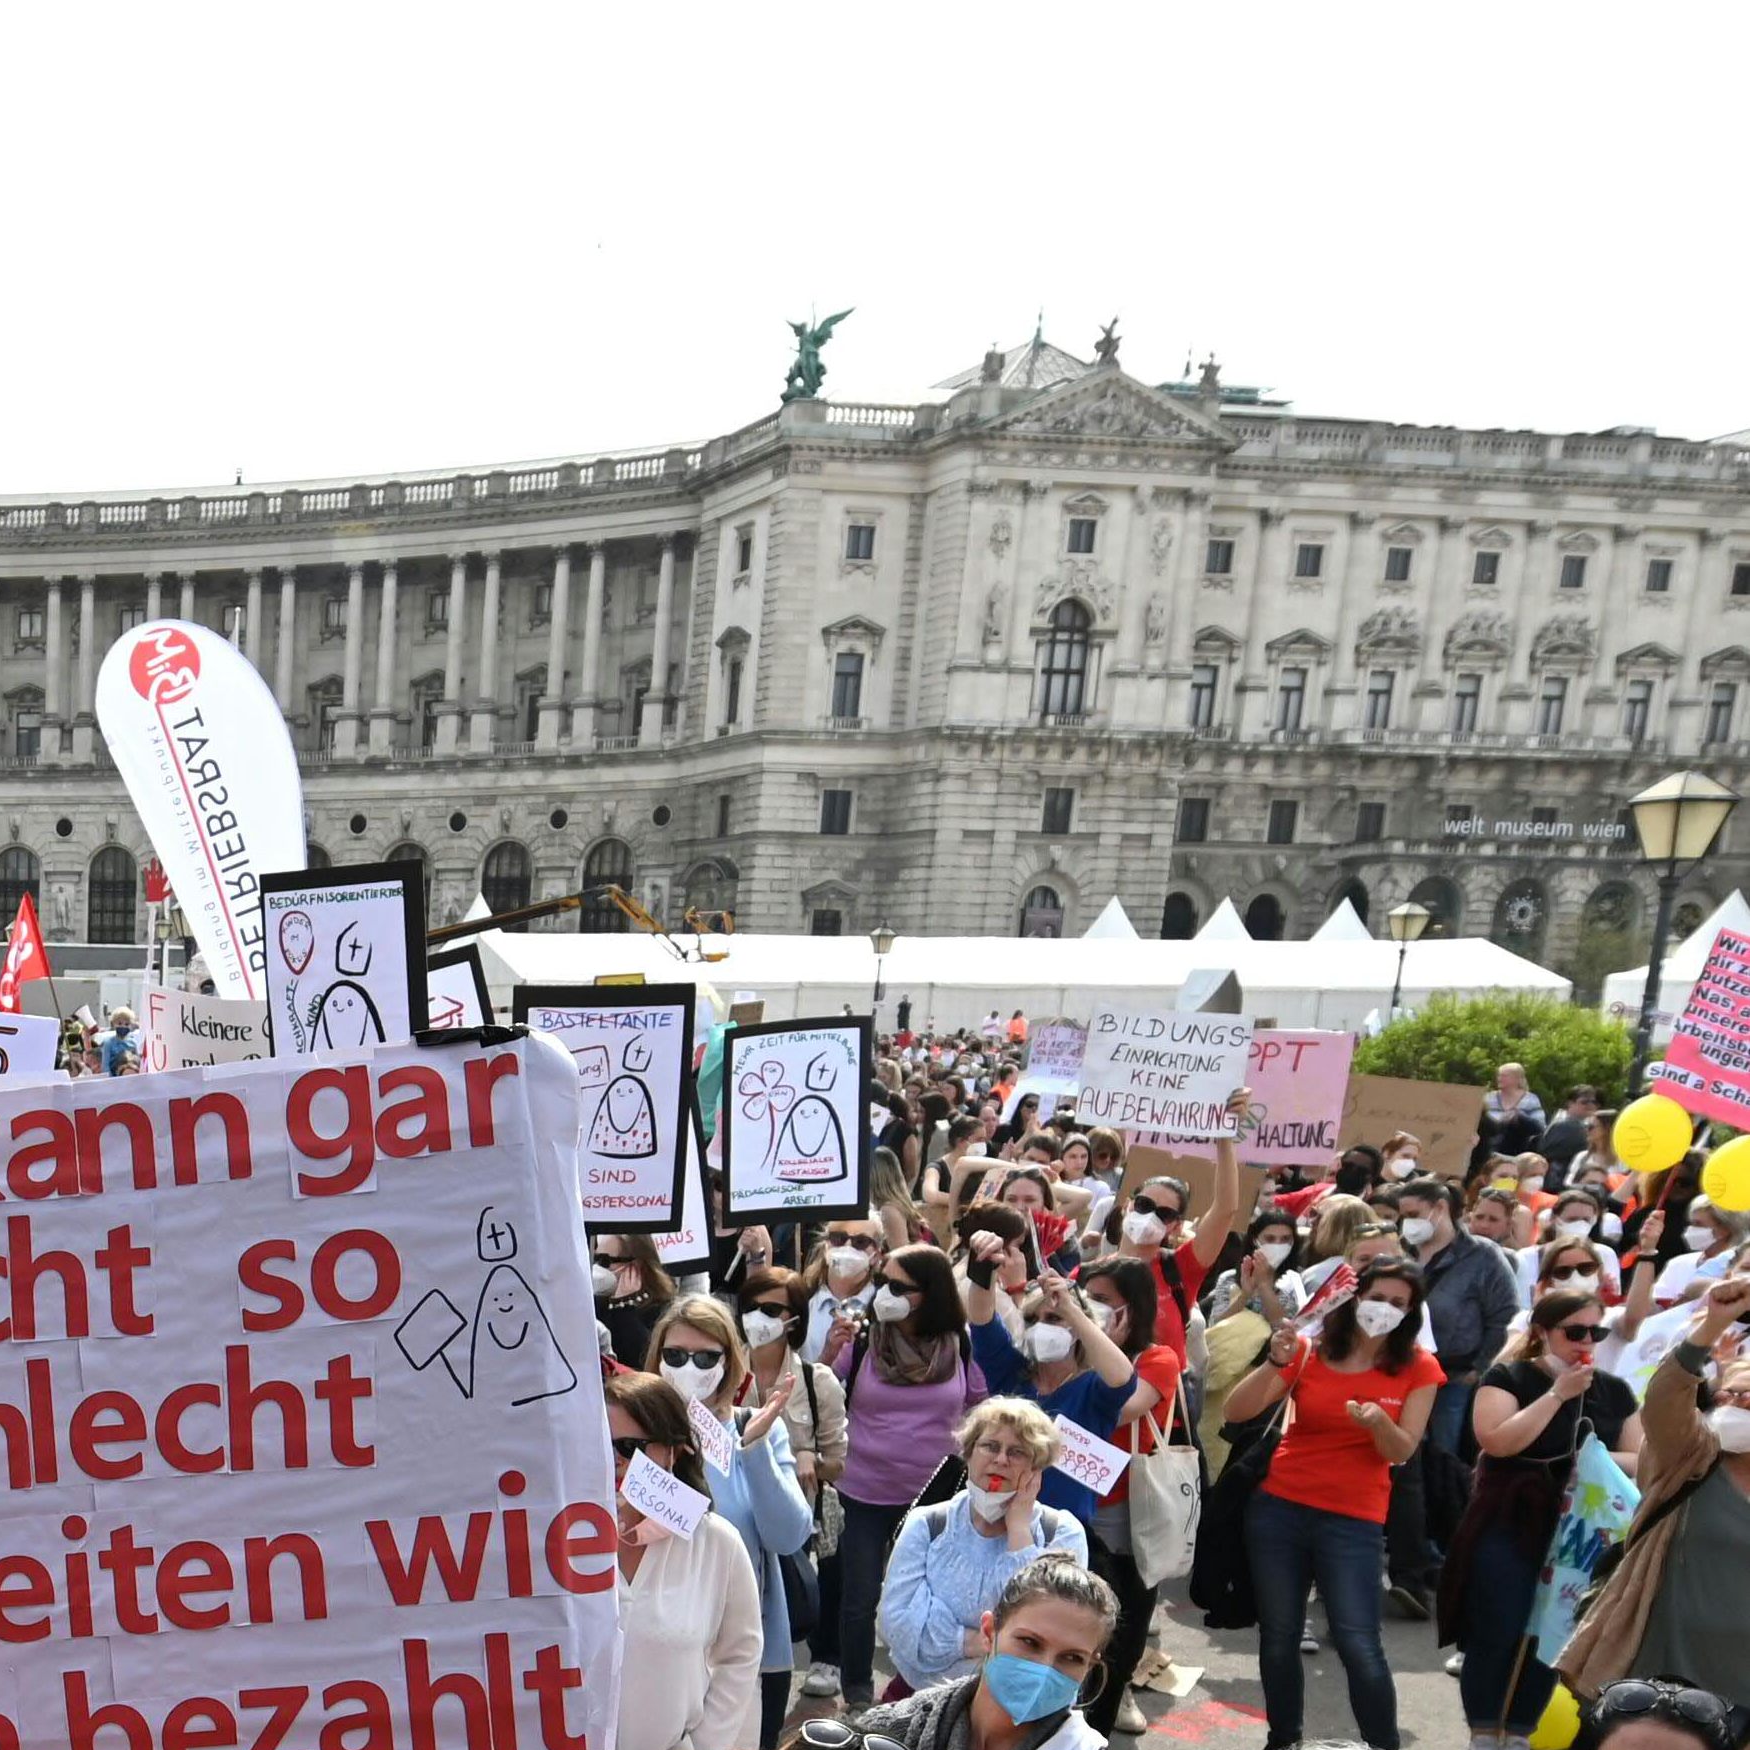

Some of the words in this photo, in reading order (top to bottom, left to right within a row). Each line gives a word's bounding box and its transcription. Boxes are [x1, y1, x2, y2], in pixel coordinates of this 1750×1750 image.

[1444, 816, 1485, 835] welt
[1495, 819, 1574, 837] museum
[1583, 817, 1626, 838] wien
[1719, 935, 1747, 956] Wir
[181, 1004, 253, 1041] kleinere
[539, 1011, 672, 1029] BASTELTANTE
[1097, 1013, 1251, 1047] BILDUNGS-
[759, 1035, 785, 1049] ZEIT
[789, 1033, 808, 1044] FÜR
[1110, 1043, 1225, 1073] EINRICHTUNG
[1130, 1069, 1190, 1090] KEINE
[1650, 1064, 1690, 1085] sind
[1078, 1086, 1238, 1131] AUFBEWAHRUNG
[286, 1051, 519, 1199] gar
[1256, 1120, 1336, 1150] HALTUNG
[588, 1168, 637, 1184] SIND
[239, 1227, 402, 1333] so
[641, 1462, 680, 1497] MEHR
[626, 1472, 691, 1534] PERSONAL
[366, 1470, 619, 1607] wie
